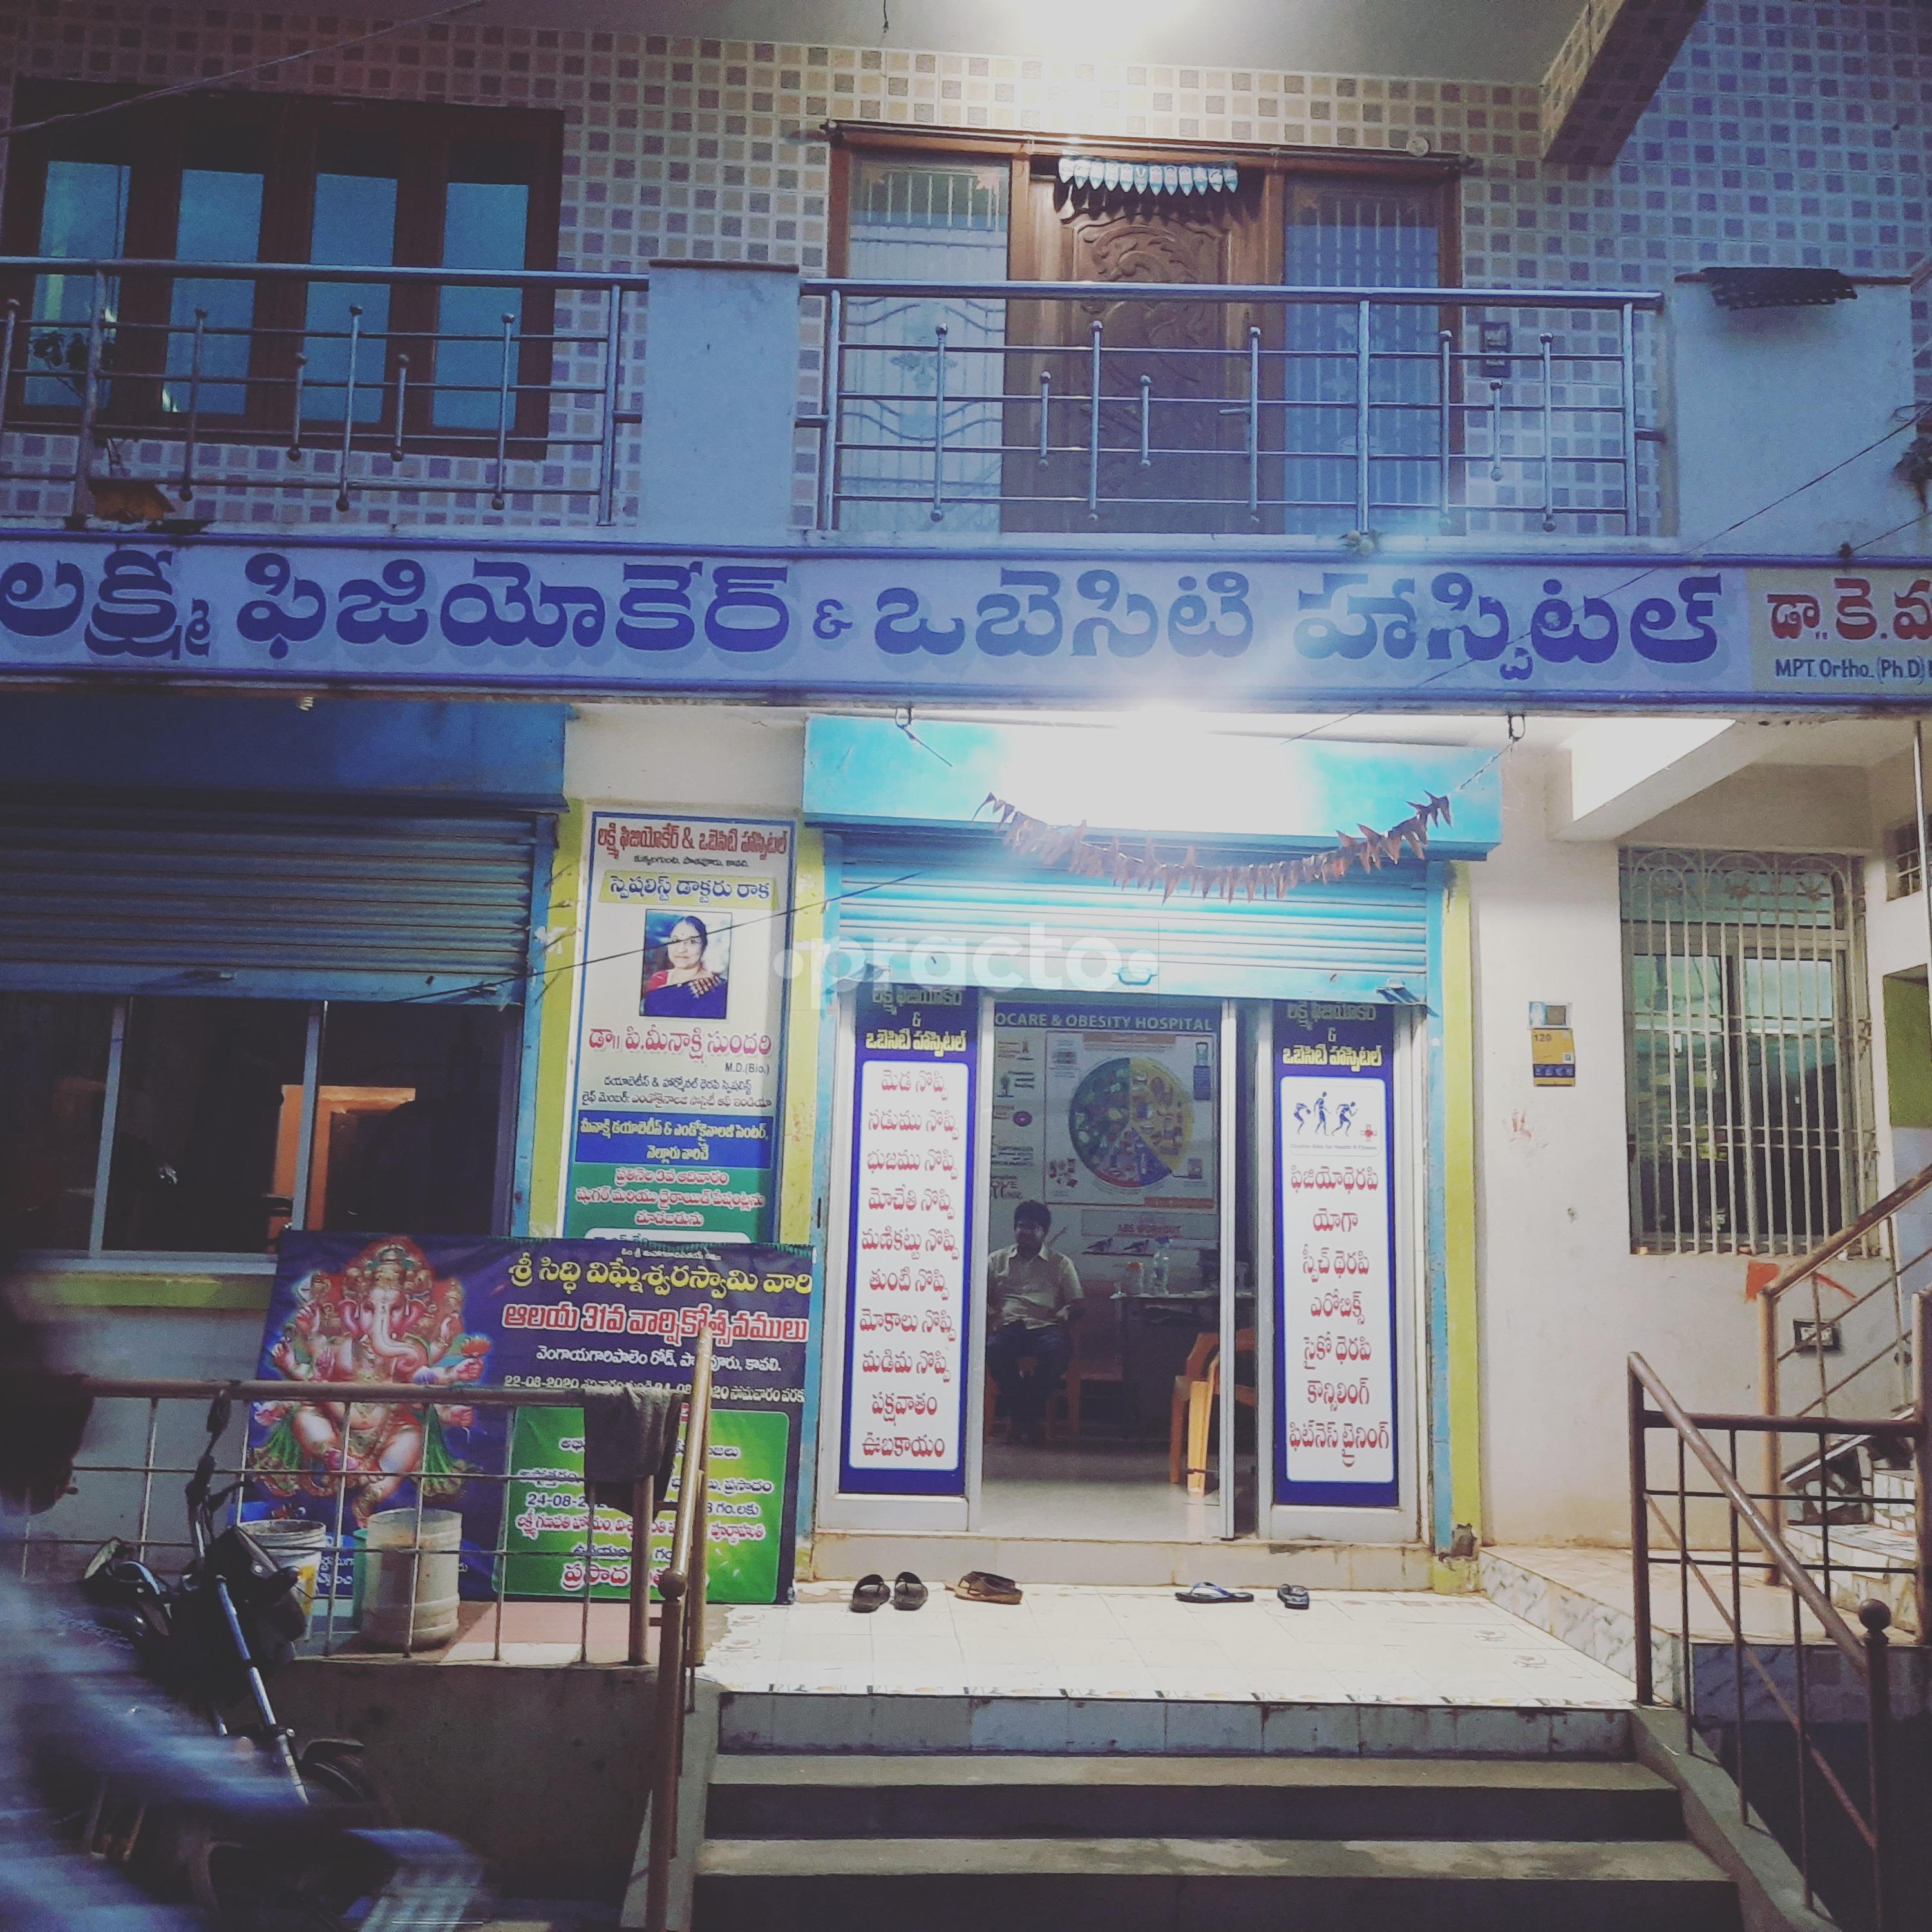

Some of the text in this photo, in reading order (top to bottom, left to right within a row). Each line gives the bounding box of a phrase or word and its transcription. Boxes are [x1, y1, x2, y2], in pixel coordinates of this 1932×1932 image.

[237, 552, 790, 660] ఫిజియోకేర్
[813, 599, 852, 639] &
[874, 568, 1254, 658] ఒబెసిటి
[1293, 572, 1722, 680] హాస్పిటల్
[682, 827, 695, 849] &
[611, 876, 770, 903] స్పెషలిస్ట్ డాక్టరు రాక
[1051, 1014, 1062, 1026] &
[1066, 1014, 1130, 1028] OBESITY
[1135, 1017, 1213, 1030] HOSPITAL
[708, 1030, 772, 1056] సుందరి
[652, 1077, 660, 1087] &
[881, 1070, 949, 1101] మెడ నొప్పి
[663, 1121, 673, 1135] &
[868, 1109, 959, 1140] నడుము నొప్పి
[867, 1149, 958, 1180] భుజము నొప్పి
[1291, 1165, 1378, 1195] ఫిజియోథెరపి
[869, 1184, 955, 1220] మోచేతి నొప్పి
[1312, 1208, 1358, 1232] యోగా
[862, 1226, 960, 1260] మణికట్టు నొప్పి
[508, 1251, 533, 1287] శ్రీ
[538, 1257, 582, 1294] సిద్ధి
[762, 1269, 813, 1294] వారి
[1334, 1250, 1370, 1278] థెరపి
[915, 1269, 949, 1301] నొప్పి
[502, 1302, 579, 1331] ఆలయ
[582, 1305, 627, 1333] 31వ
[860, 1309, 956, 1341] మోకాలు నొప్పి
[1303, 1331, 1372, 1370] సైకో థెరపి
[504, 1375, 579, 1389] 22-08-2020
[916, 1350, 951, 1383] నొప్పి
[872, 1392, 937, 1426] పక్షవాతం
